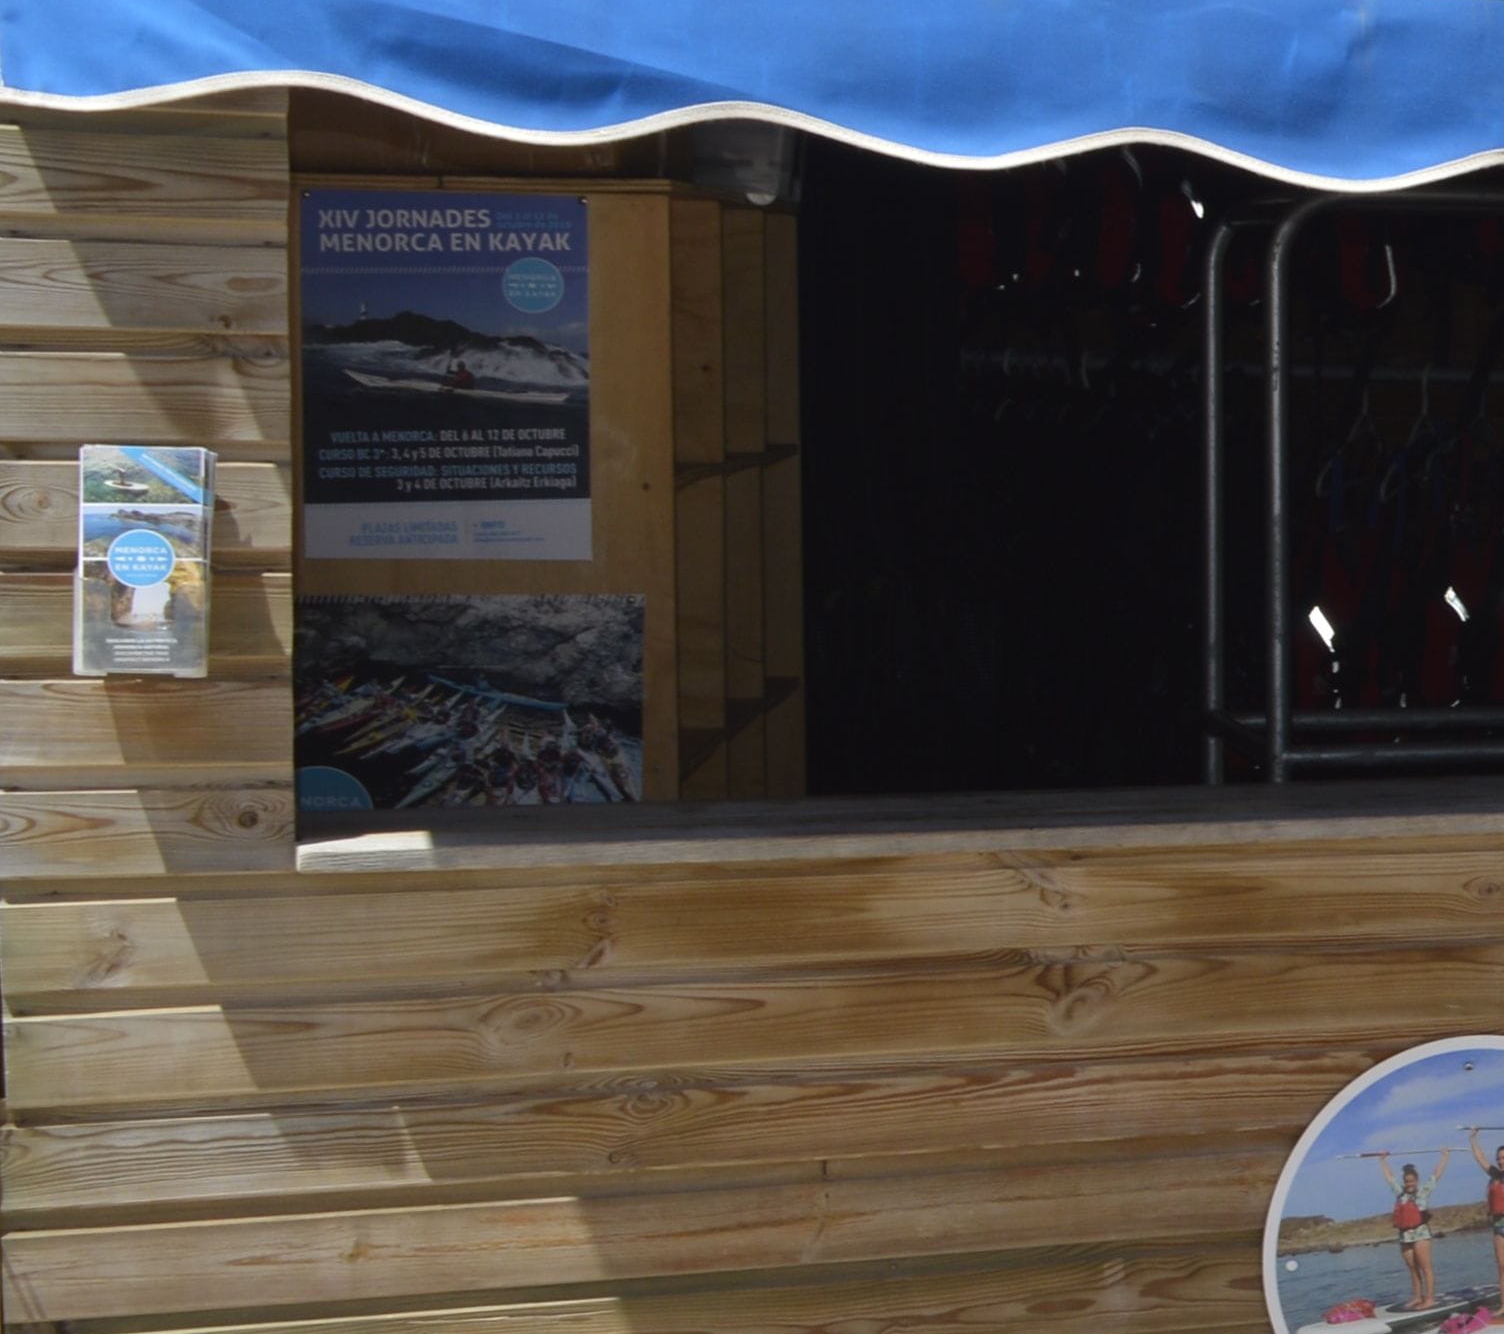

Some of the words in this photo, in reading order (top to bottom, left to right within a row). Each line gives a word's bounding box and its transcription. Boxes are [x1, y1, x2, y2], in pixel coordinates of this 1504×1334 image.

[318, 209, 360, 229] XIV
[366, 209, 491, 229] JORNADES
[320, 233, 444, 253] MENORCA
[450, 233, 481, 251] EN
[489, 233, 571, 251] KAYAK
[440, 429, 460, 441] DEL
[472, 429, 484, 441] AL
[501, 429, 515, 441] DE
[518, 428, 567, 440] OCTUBRE
[428, 447, 440, 458] DE
[444, 446, 489, 458] OCTUBRE
[115, 546, 168, 554] MENORCA
